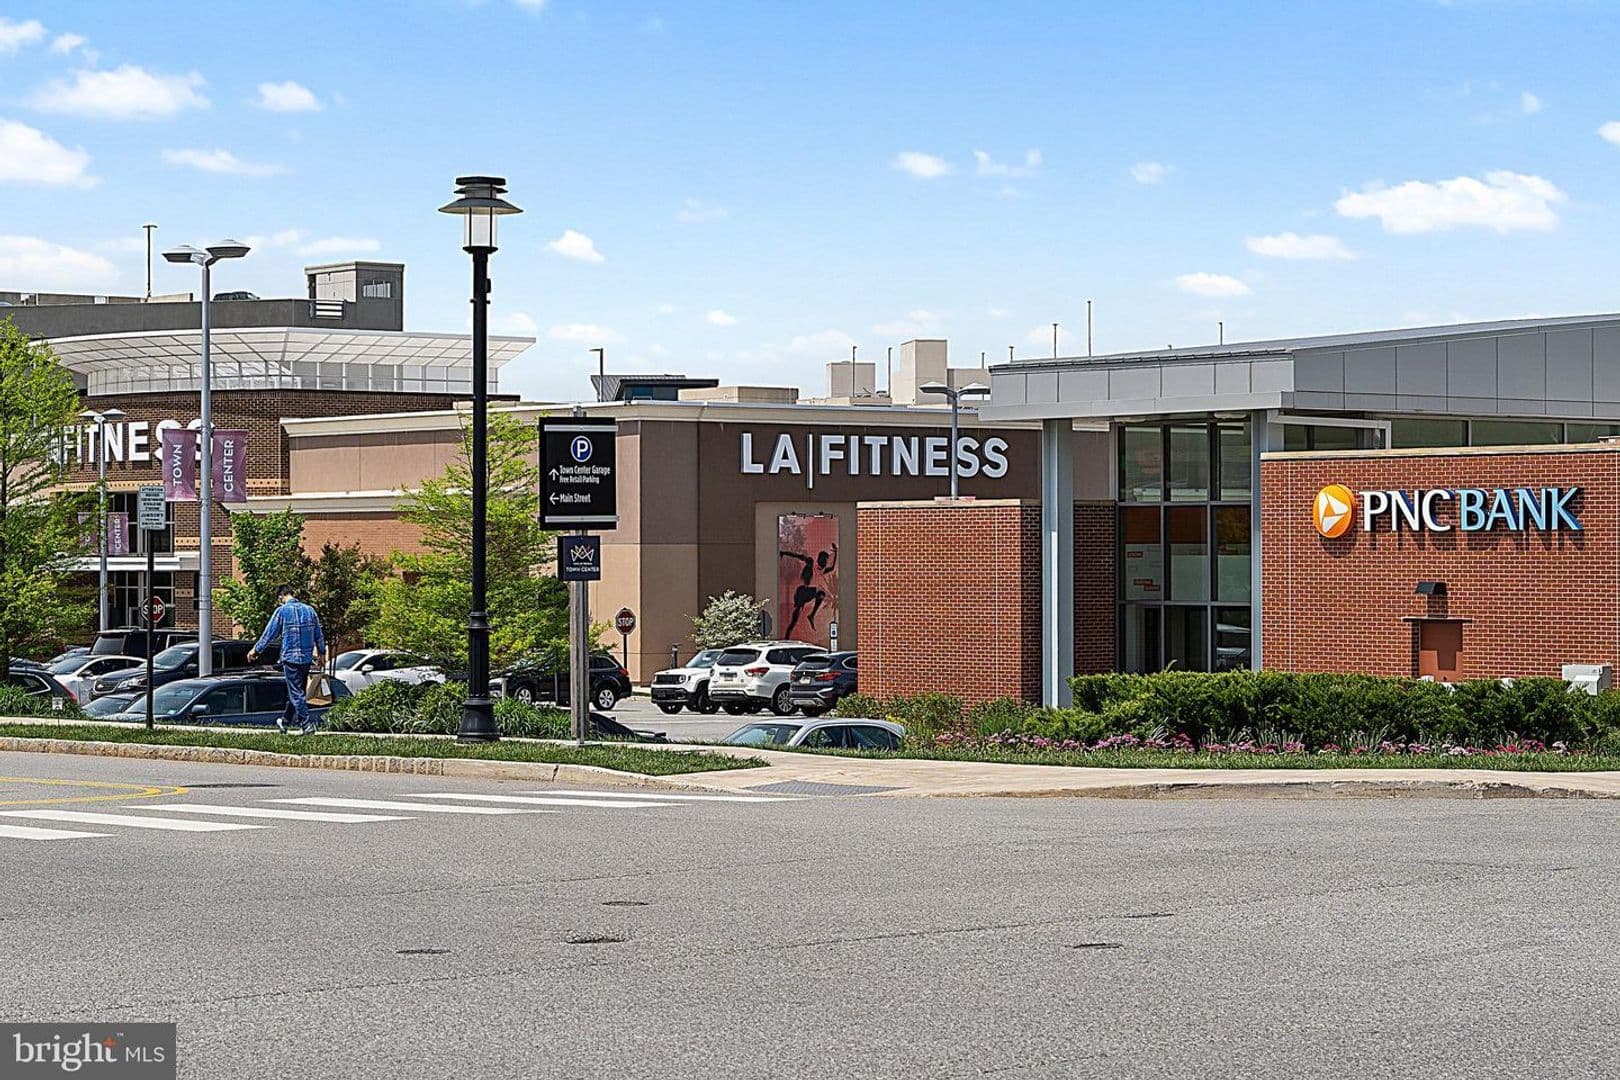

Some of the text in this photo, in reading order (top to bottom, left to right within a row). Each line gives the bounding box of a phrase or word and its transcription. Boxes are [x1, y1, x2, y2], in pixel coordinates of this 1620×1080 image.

[741, 432, 1009, 478] LA FITNESS
[173, 444, 183, 487] TOWN
[223, 439, 234, 492] CENTER
[560, 465, 611, 476] Town Center Garage
[560, 475, 600, 484] Free Retail Parking
[560, 493, 591, 503] Main Street
[1358, 487, 1584, 532] PNC BANK
[142, 605, 163, 614] SOP
[618, 617, 634, 627] STOP
